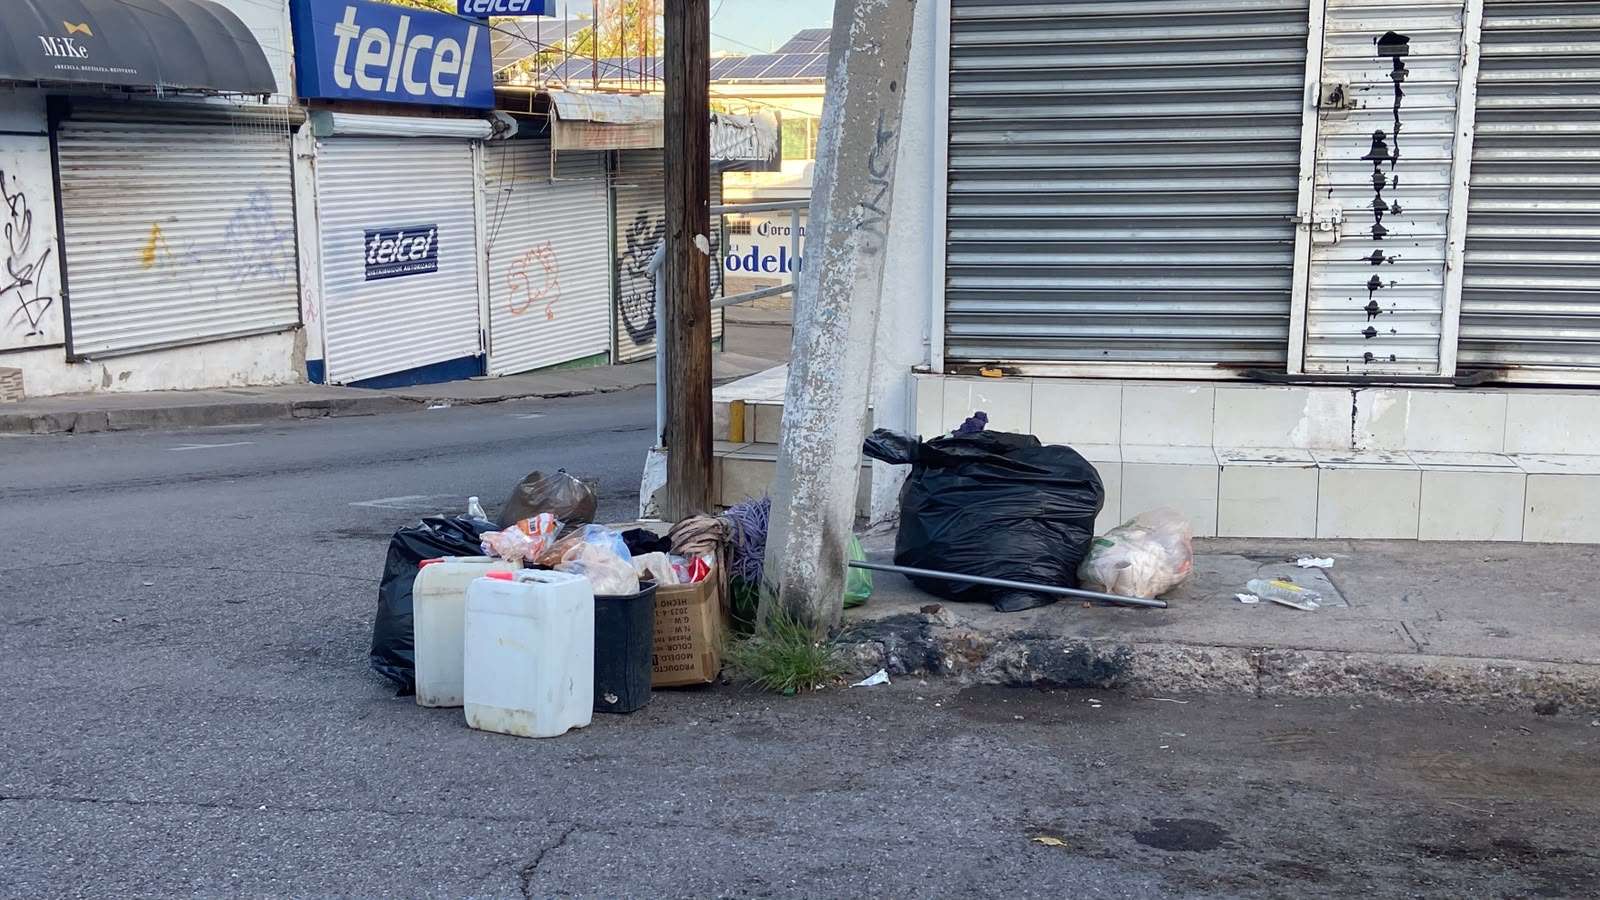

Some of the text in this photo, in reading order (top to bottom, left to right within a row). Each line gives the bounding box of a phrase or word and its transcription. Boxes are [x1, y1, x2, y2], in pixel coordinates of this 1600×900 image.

[38, 35, 89, 59] MiKe
[333, 6, 479, 98] telcel
[757, 220, 806, 238] Coroa
[367, 229, 434, 264] telcel
[726, 245, 803, 273] odelo
